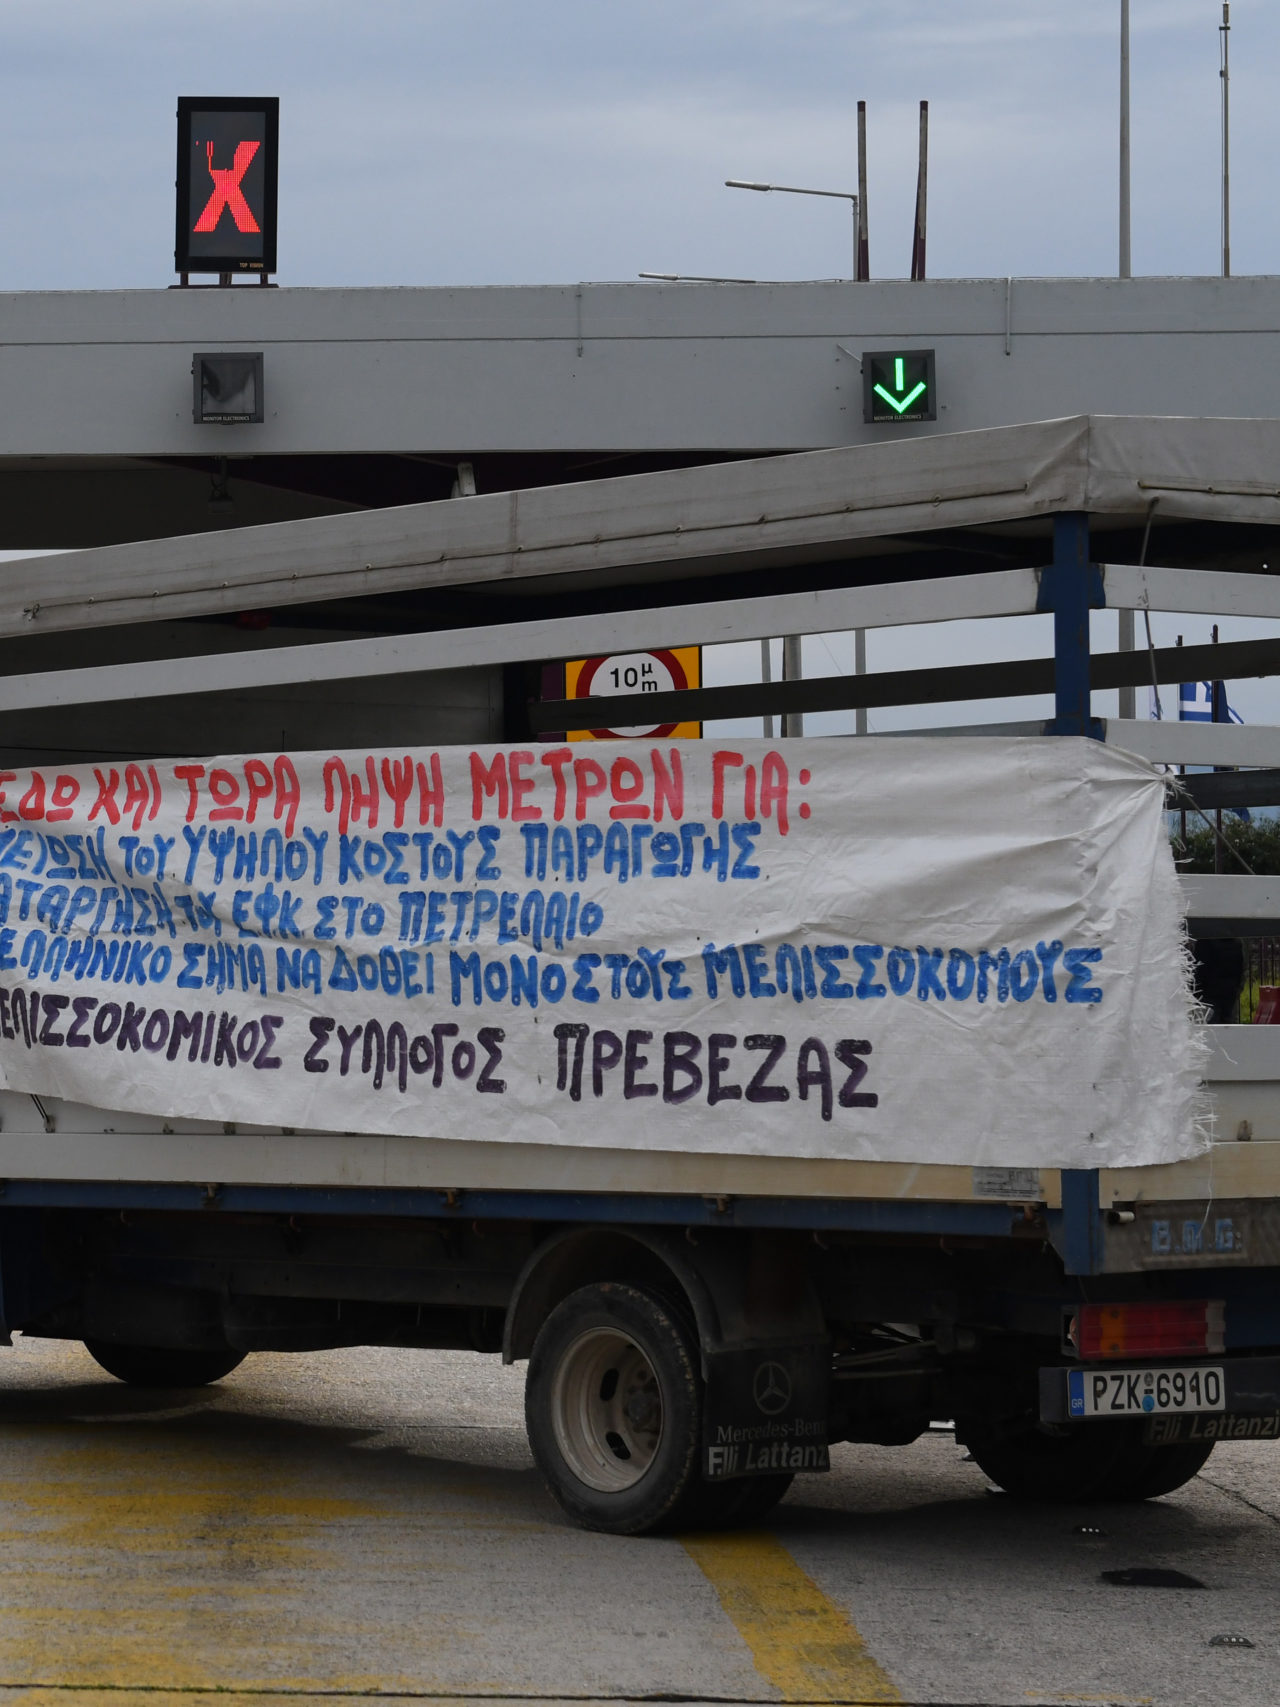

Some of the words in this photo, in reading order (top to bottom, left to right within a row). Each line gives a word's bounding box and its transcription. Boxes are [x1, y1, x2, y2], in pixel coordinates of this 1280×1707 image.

[610, 667, 638, 688] 10
[641, 680, 658, 692] m
[174, 754, 300, 838] ΤΩΡΑ
[469, 747, 684, 822] ΜΕΤΡΩΝ
[339, 824, 501, 885] ΚΟΣΤΟΥΣ
[520, 821, 762, 882] ΠΑΡΑΓΩΓΗΣ
[232, 882, 304, 939] ΕΦΚ
[314, 896, 385, 939] ΣΤΟ
[176, 941, 268, 998] ΣΗΜΑ
[276, 945, 322, 998] ΝΑ
[328, 944, 435, 999] ΔΟΘΕΙ
[449, 951, 567, 1008] ΜΟΝΟ
[572, 947, 694, 1003] ΣΤΟΥΣ
[553, 1022, 879, 1121] ΠΡΕΒΕΖΑΣ
[1071, 1398, 1084, 1409] GR
[716, 1418, 825, 1443] Mercedes-Ben
[1189, 1411, 1280, 1438] Lattanzi
[745, 1441, 827, 1470] Lattanz
